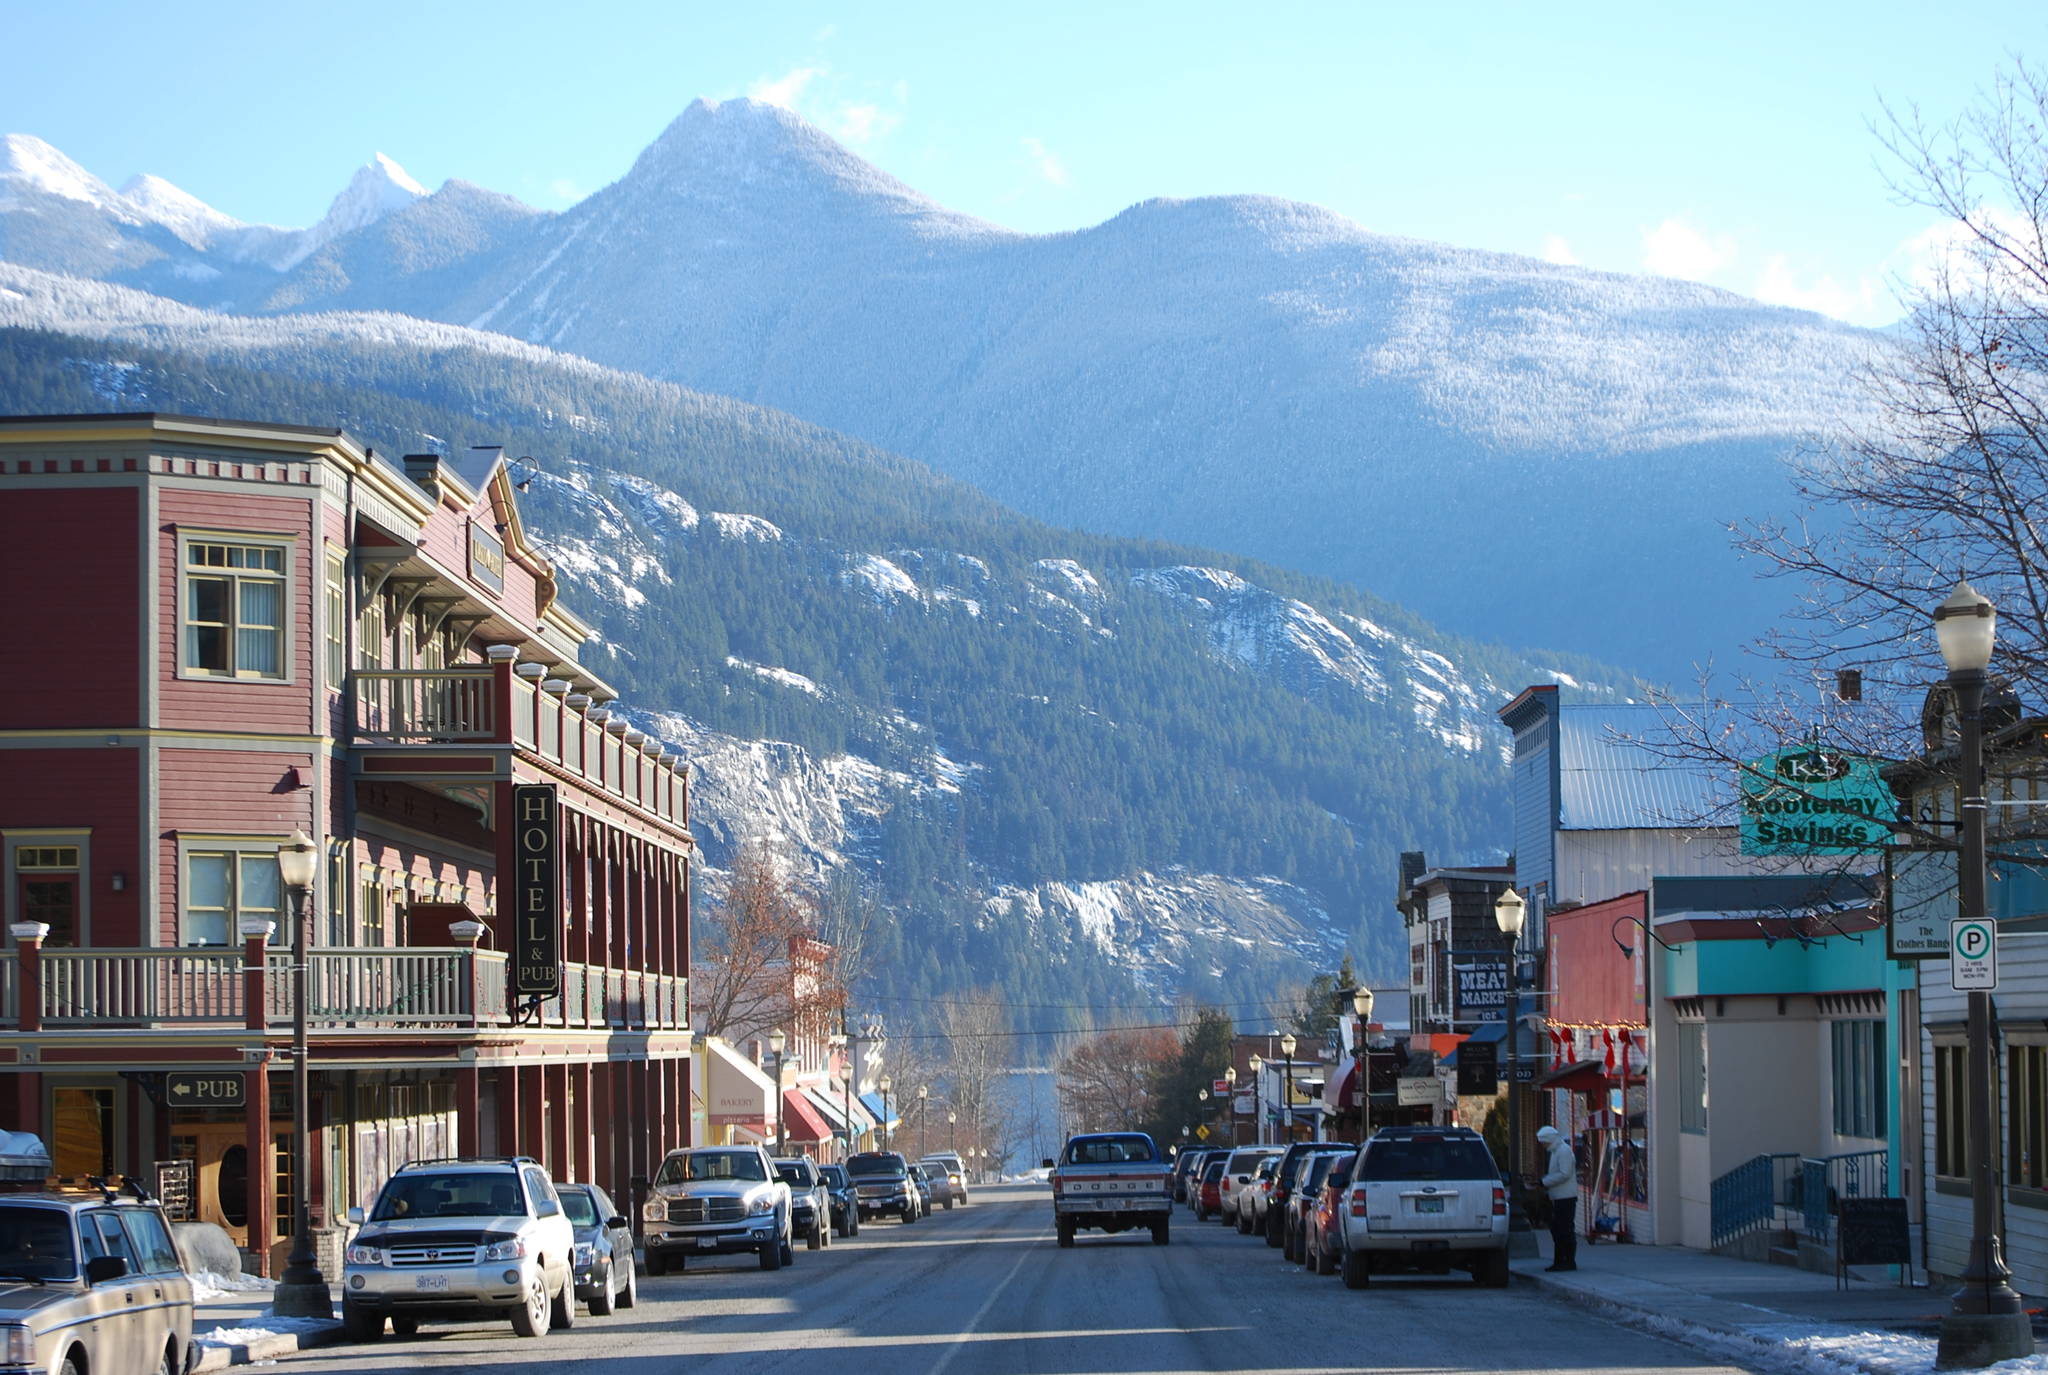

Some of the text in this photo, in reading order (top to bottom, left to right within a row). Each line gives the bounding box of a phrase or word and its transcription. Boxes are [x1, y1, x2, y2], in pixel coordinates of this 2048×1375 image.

[1757, 821, 1868, 844] Savings
[522, 796, 548, 942] HOTEL
[1919, 926, 1934, 936] The
[1896, 939, 1950, 950] Clothes Hang
[1967, 932, 1981, 951] P
[531, 947, 543, 961] &
[519, 966, 555, 981] PUB
[1460, 972, 1507, 990] MEAT
[1461, 991, 1505, 1005] MARKE
[1482, 1011, 1497, 1020] ICE
[196, 1080, 239, 1098] PUB
[721, 1098, 753, 1106] BAKERY
[1073, 1182, 1154, 1191] DODGE
